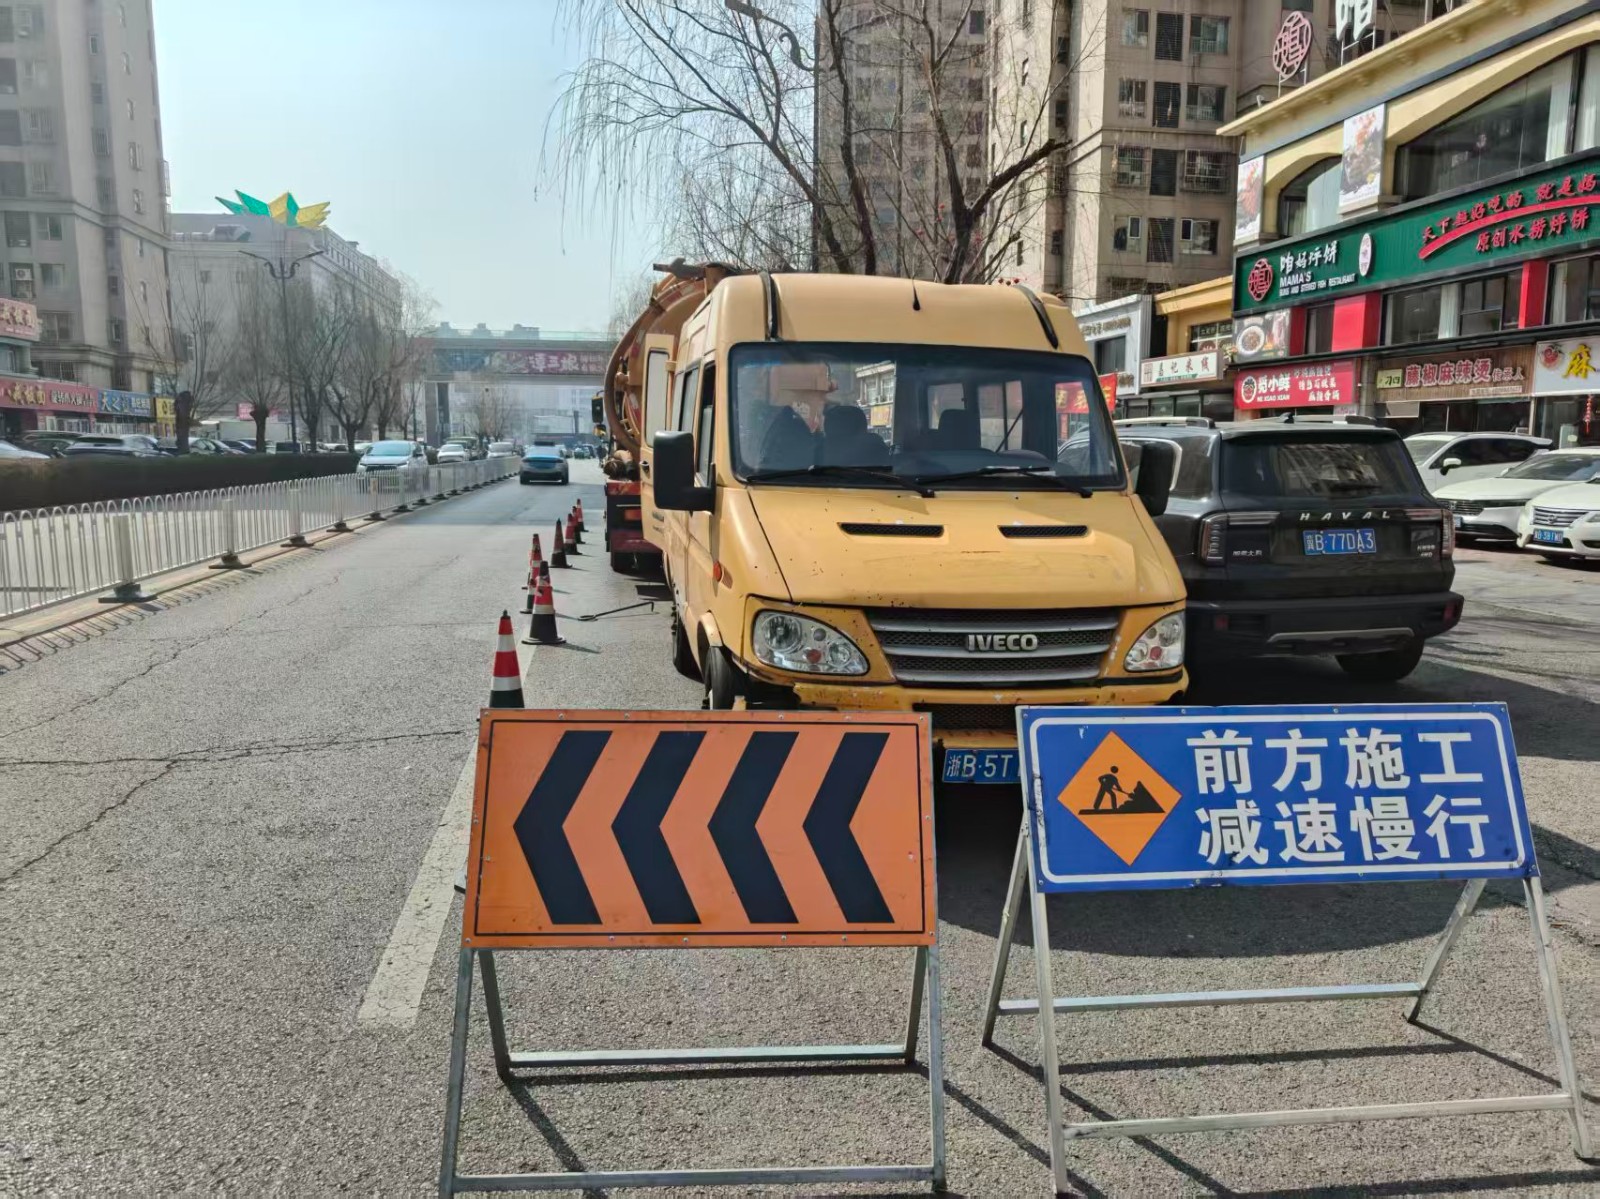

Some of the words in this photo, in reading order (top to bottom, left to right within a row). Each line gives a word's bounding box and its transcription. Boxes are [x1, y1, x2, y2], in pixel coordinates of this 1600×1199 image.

[1280, 271, 1312, 288] MAMA'S
[1404, 358, 1492, 388] 藤椒麻辣烫
[1492, 366, 1524, 381] 传承人
[1563, 343, 1596, 380] 麻
[1300, 511, 1390, 521] HAVAL
[967, 634, 1039, 651] IVECO
[946, 754, 1021, 778] 浙B·5T
[1186, 727, 1484, 794] 前方施工
[1194, 794, 1490, 866] 减速慢行
